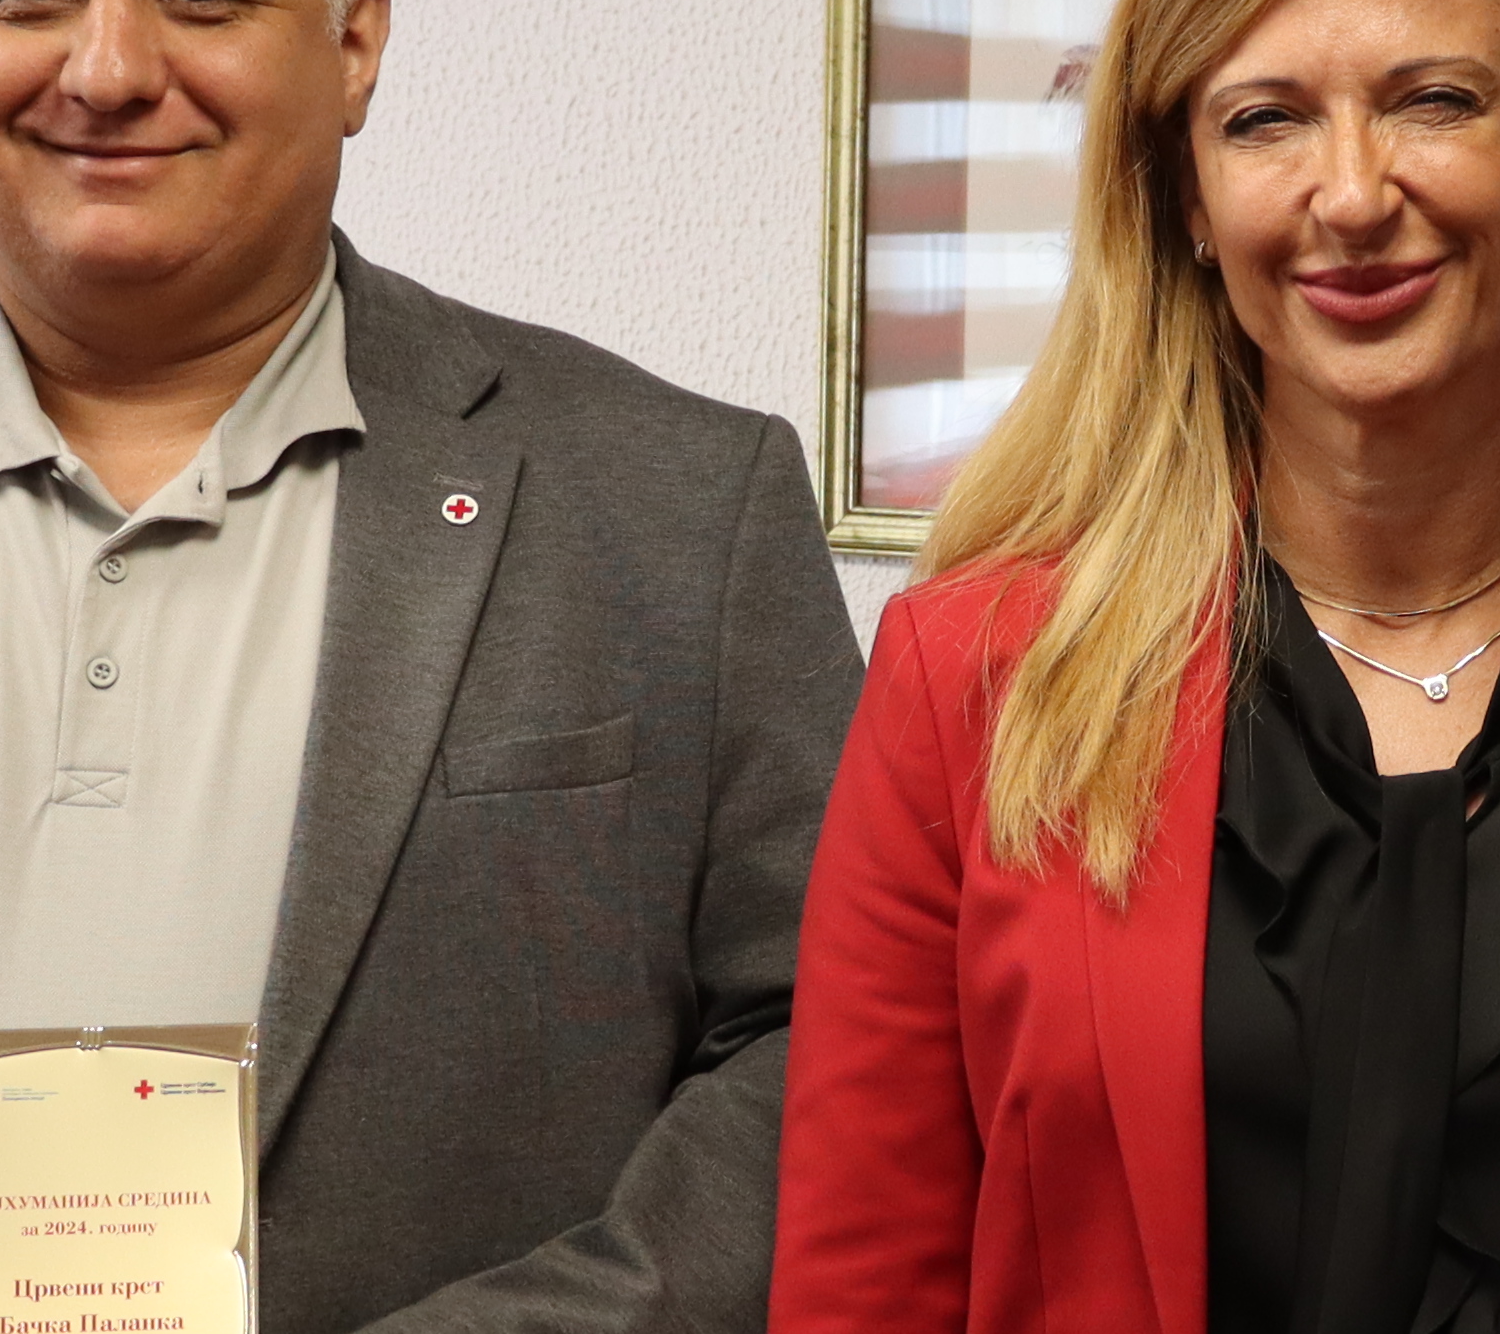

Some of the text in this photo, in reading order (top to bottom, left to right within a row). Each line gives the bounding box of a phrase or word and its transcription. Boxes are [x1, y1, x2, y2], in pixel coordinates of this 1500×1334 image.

[117, 1191, 211, 1207] СРЕДИНА
[20, 1220, 156, 1237] за 2024. годину
[14, 1279, 164, 1303] Црвени крст
[0, 1313, 184, 1334] Бачка Паланка
